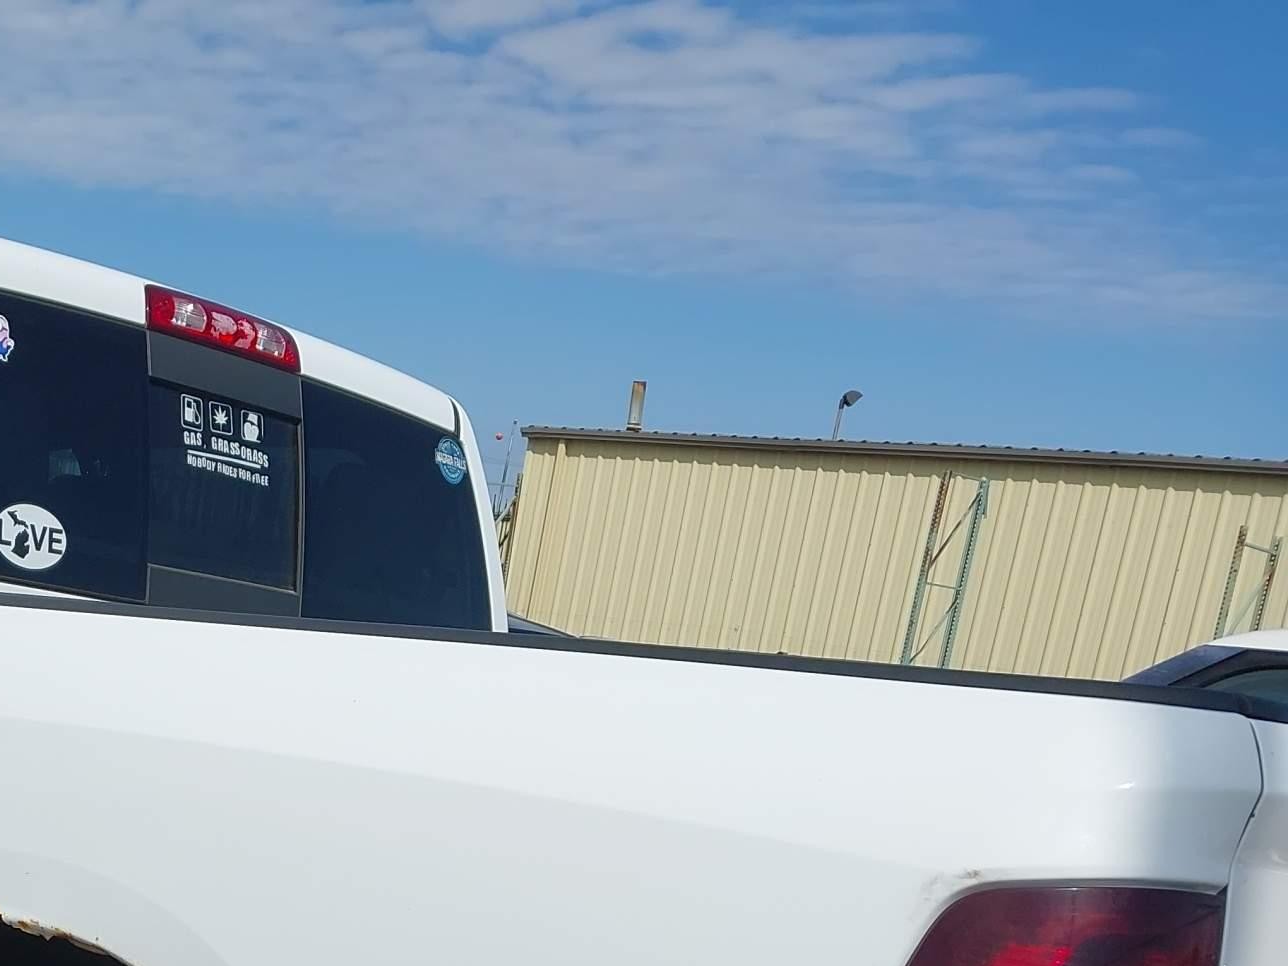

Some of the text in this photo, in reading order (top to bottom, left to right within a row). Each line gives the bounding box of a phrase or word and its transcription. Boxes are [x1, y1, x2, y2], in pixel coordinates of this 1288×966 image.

[211, 436, 241, 456] GRASS
[187, 454, 270, 487] NOBODY RIDES FOR FREE
